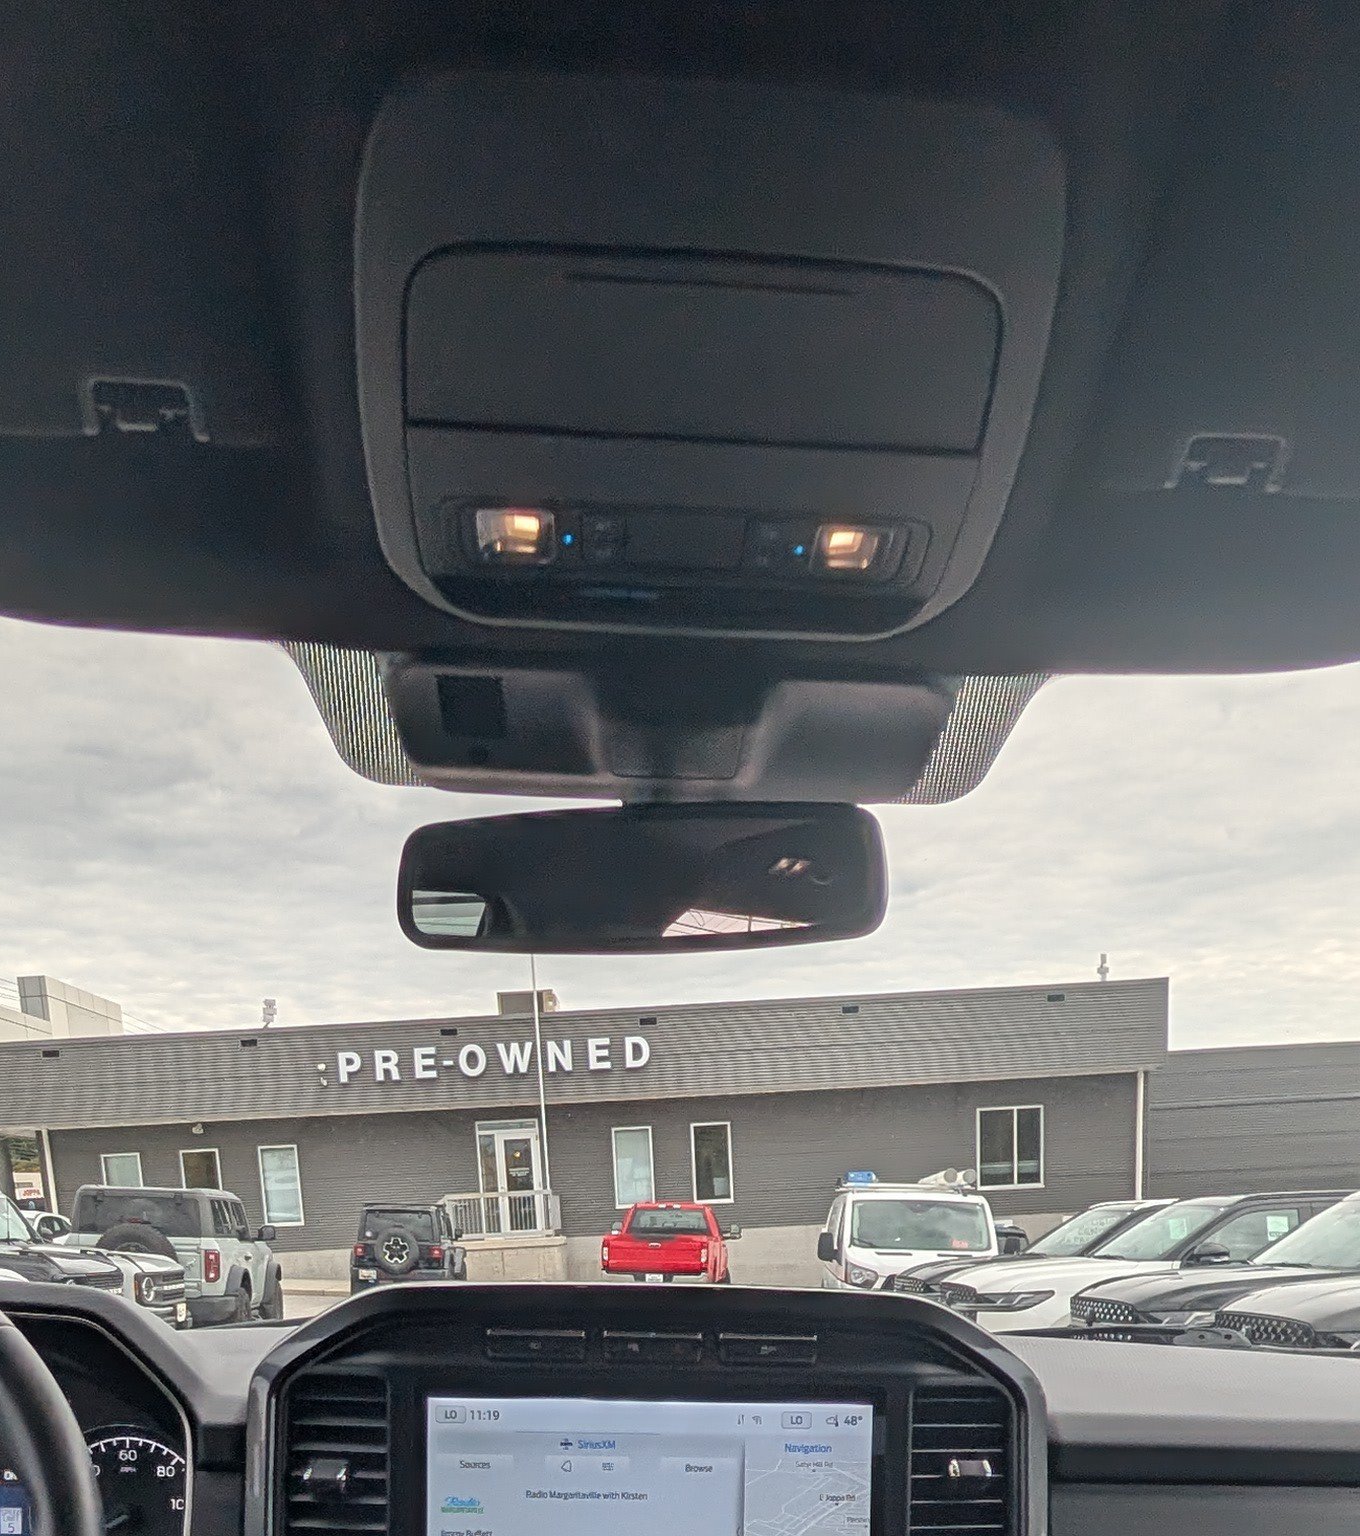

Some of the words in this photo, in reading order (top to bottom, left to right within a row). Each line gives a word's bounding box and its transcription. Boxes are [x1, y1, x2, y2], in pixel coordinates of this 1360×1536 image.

[337, 1035, 651, 1084] PRE-OWNED
[444, 1410, 458, 1420] LO
[469, 1409, 501, 1421] 11:19
[790, 1415, 804, 1425] LO
[783, 1442, 833, 1455] Navigation
[119, 1449, 138, 1462] 60
[156, 1465, 176, 1478] 80
[685, 1463, 713, 1474] Browse
[602, 1490, 620, 1500] with
